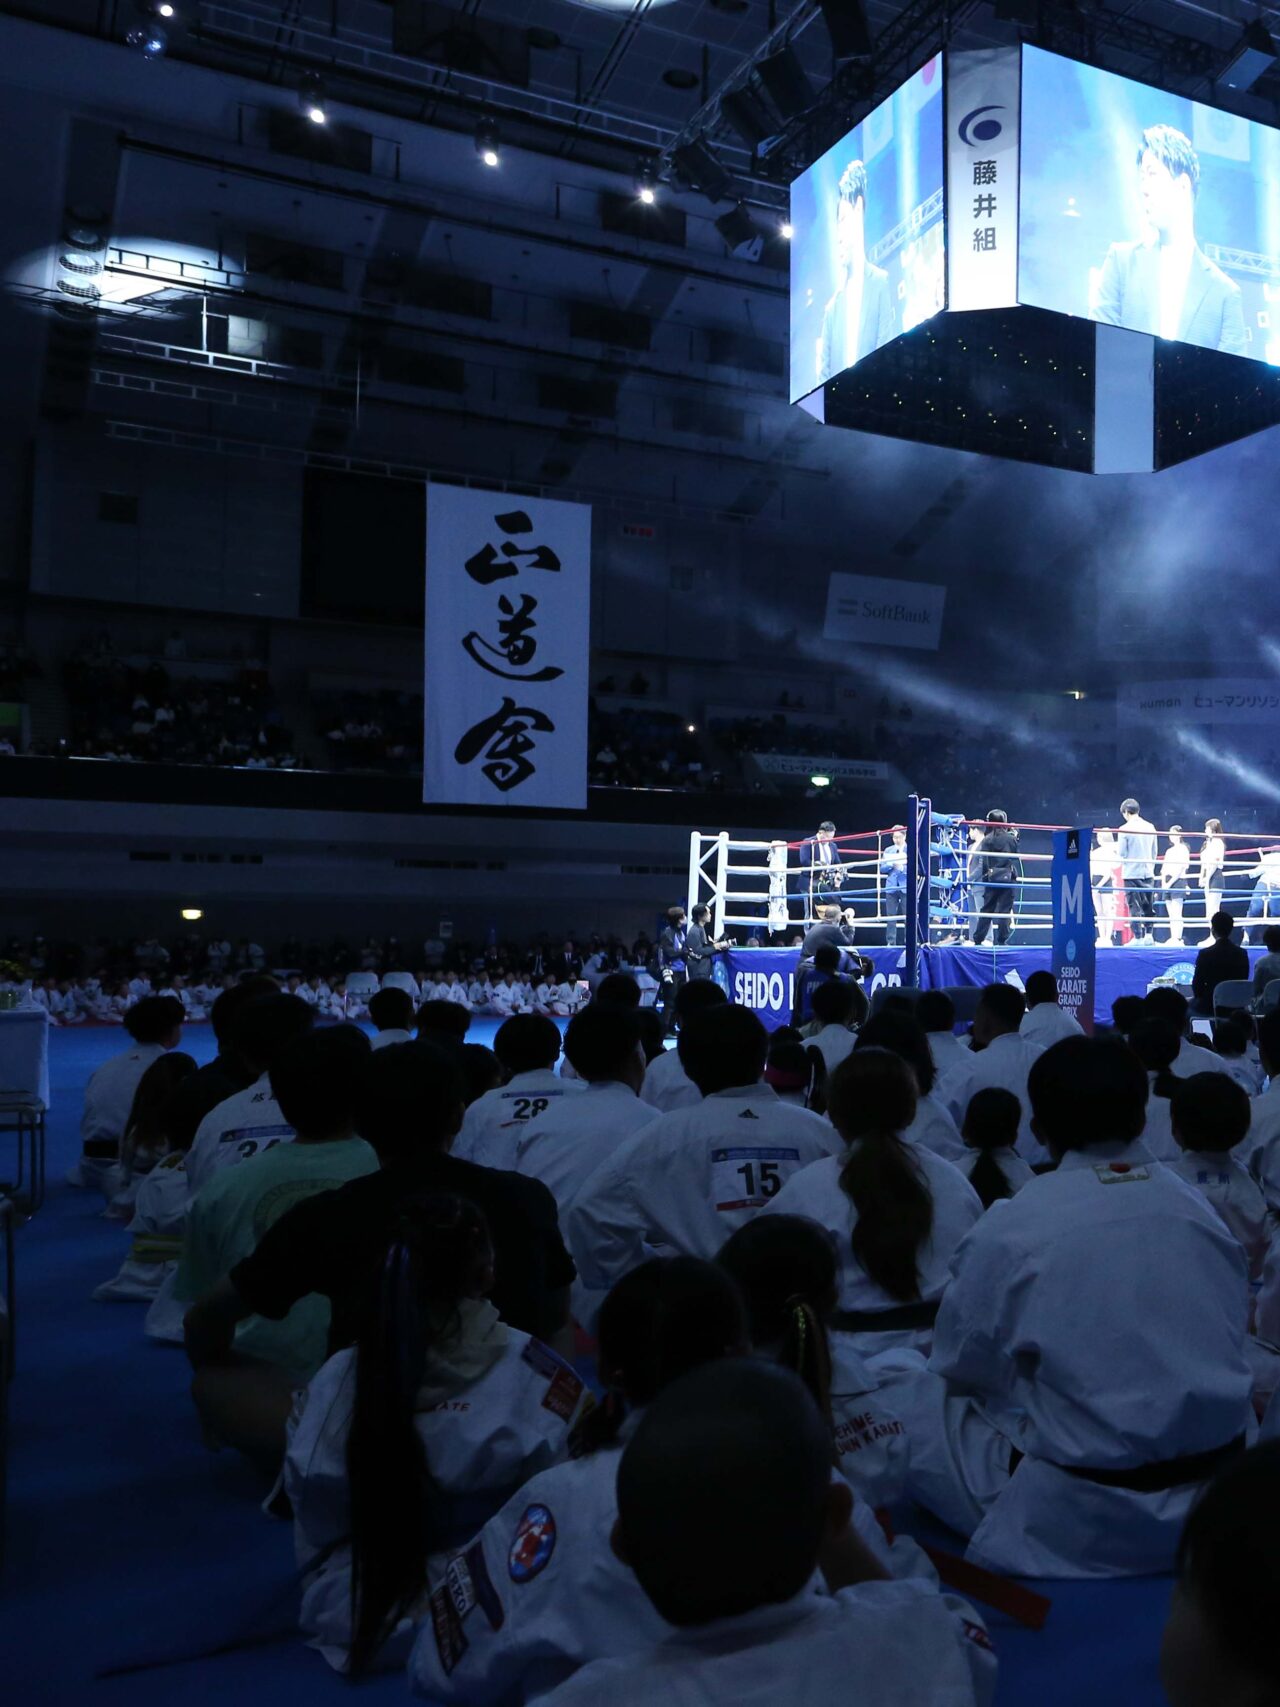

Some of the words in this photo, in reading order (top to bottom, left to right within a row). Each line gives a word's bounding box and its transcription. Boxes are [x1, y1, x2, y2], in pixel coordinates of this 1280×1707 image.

[973, 160, 997, 253] 藤井組
[862, 601, 931, 624] SoftBank
[1060, 873, 1084, 925] M
[1061, 966, 1081, 979] SEIDO
[735, 971, 785, 1011] SEIDO
[1058, 993, 1083, 1006] GRAND
[737, 1162, 781, 1197] 15
